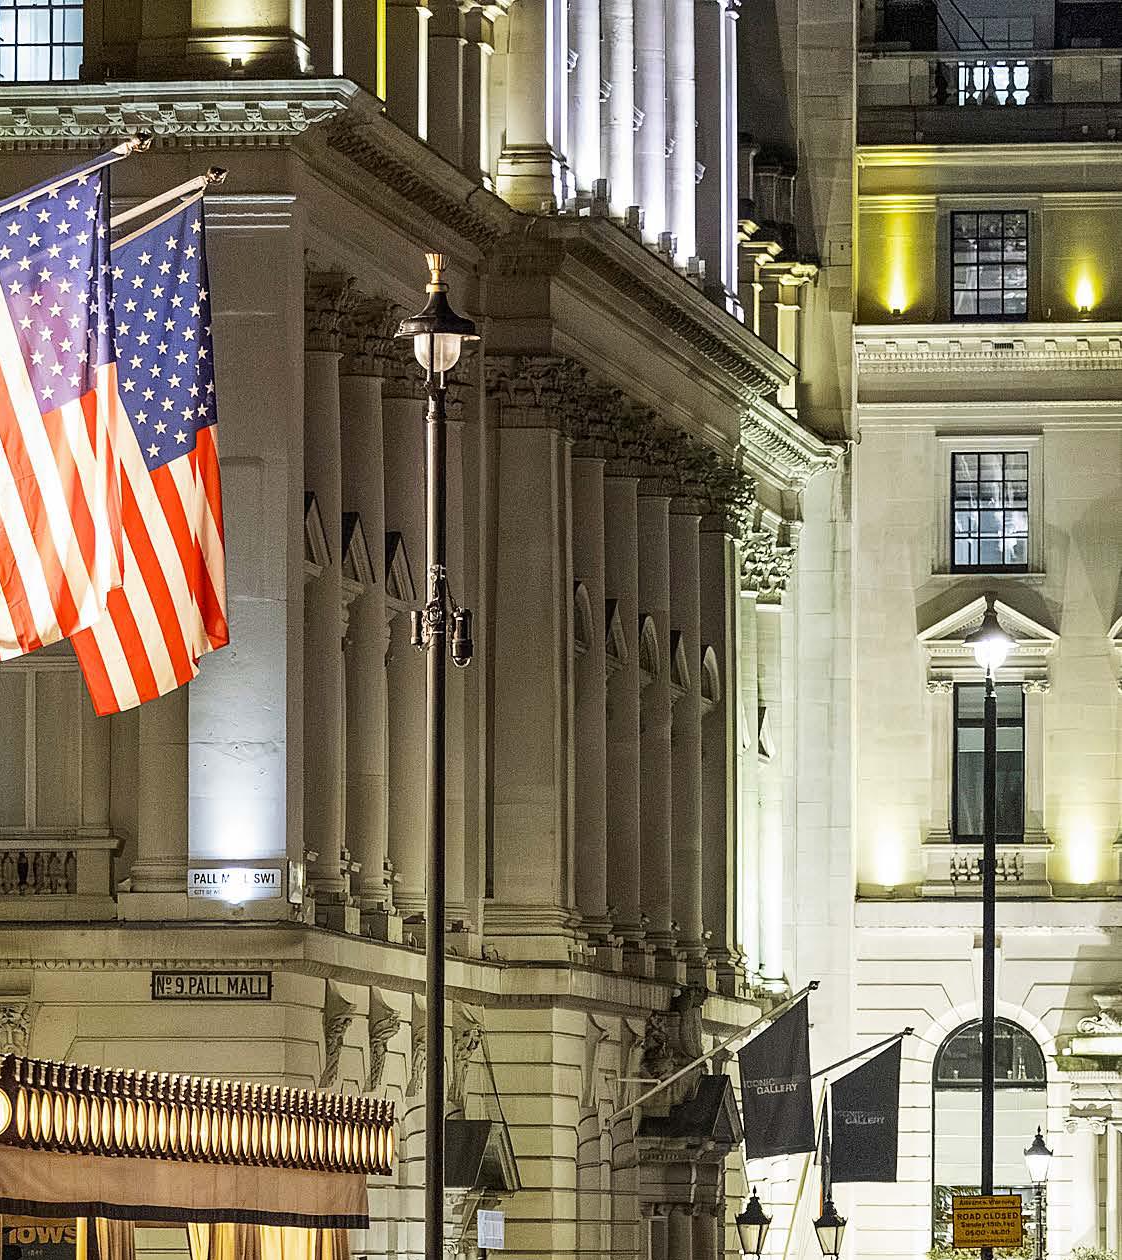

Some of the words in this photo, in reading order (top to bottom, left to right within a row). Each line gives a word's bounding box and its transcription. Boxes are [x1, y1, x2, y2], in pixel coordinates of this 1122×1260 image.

[193, 873, 218, 884] PALL
[221, 873, 251, 884] ML
[254, 873, 275, 884] SW1
[227, 976, 267, 995] MALL
[756, 1083, 797, 1095] GALLERY
